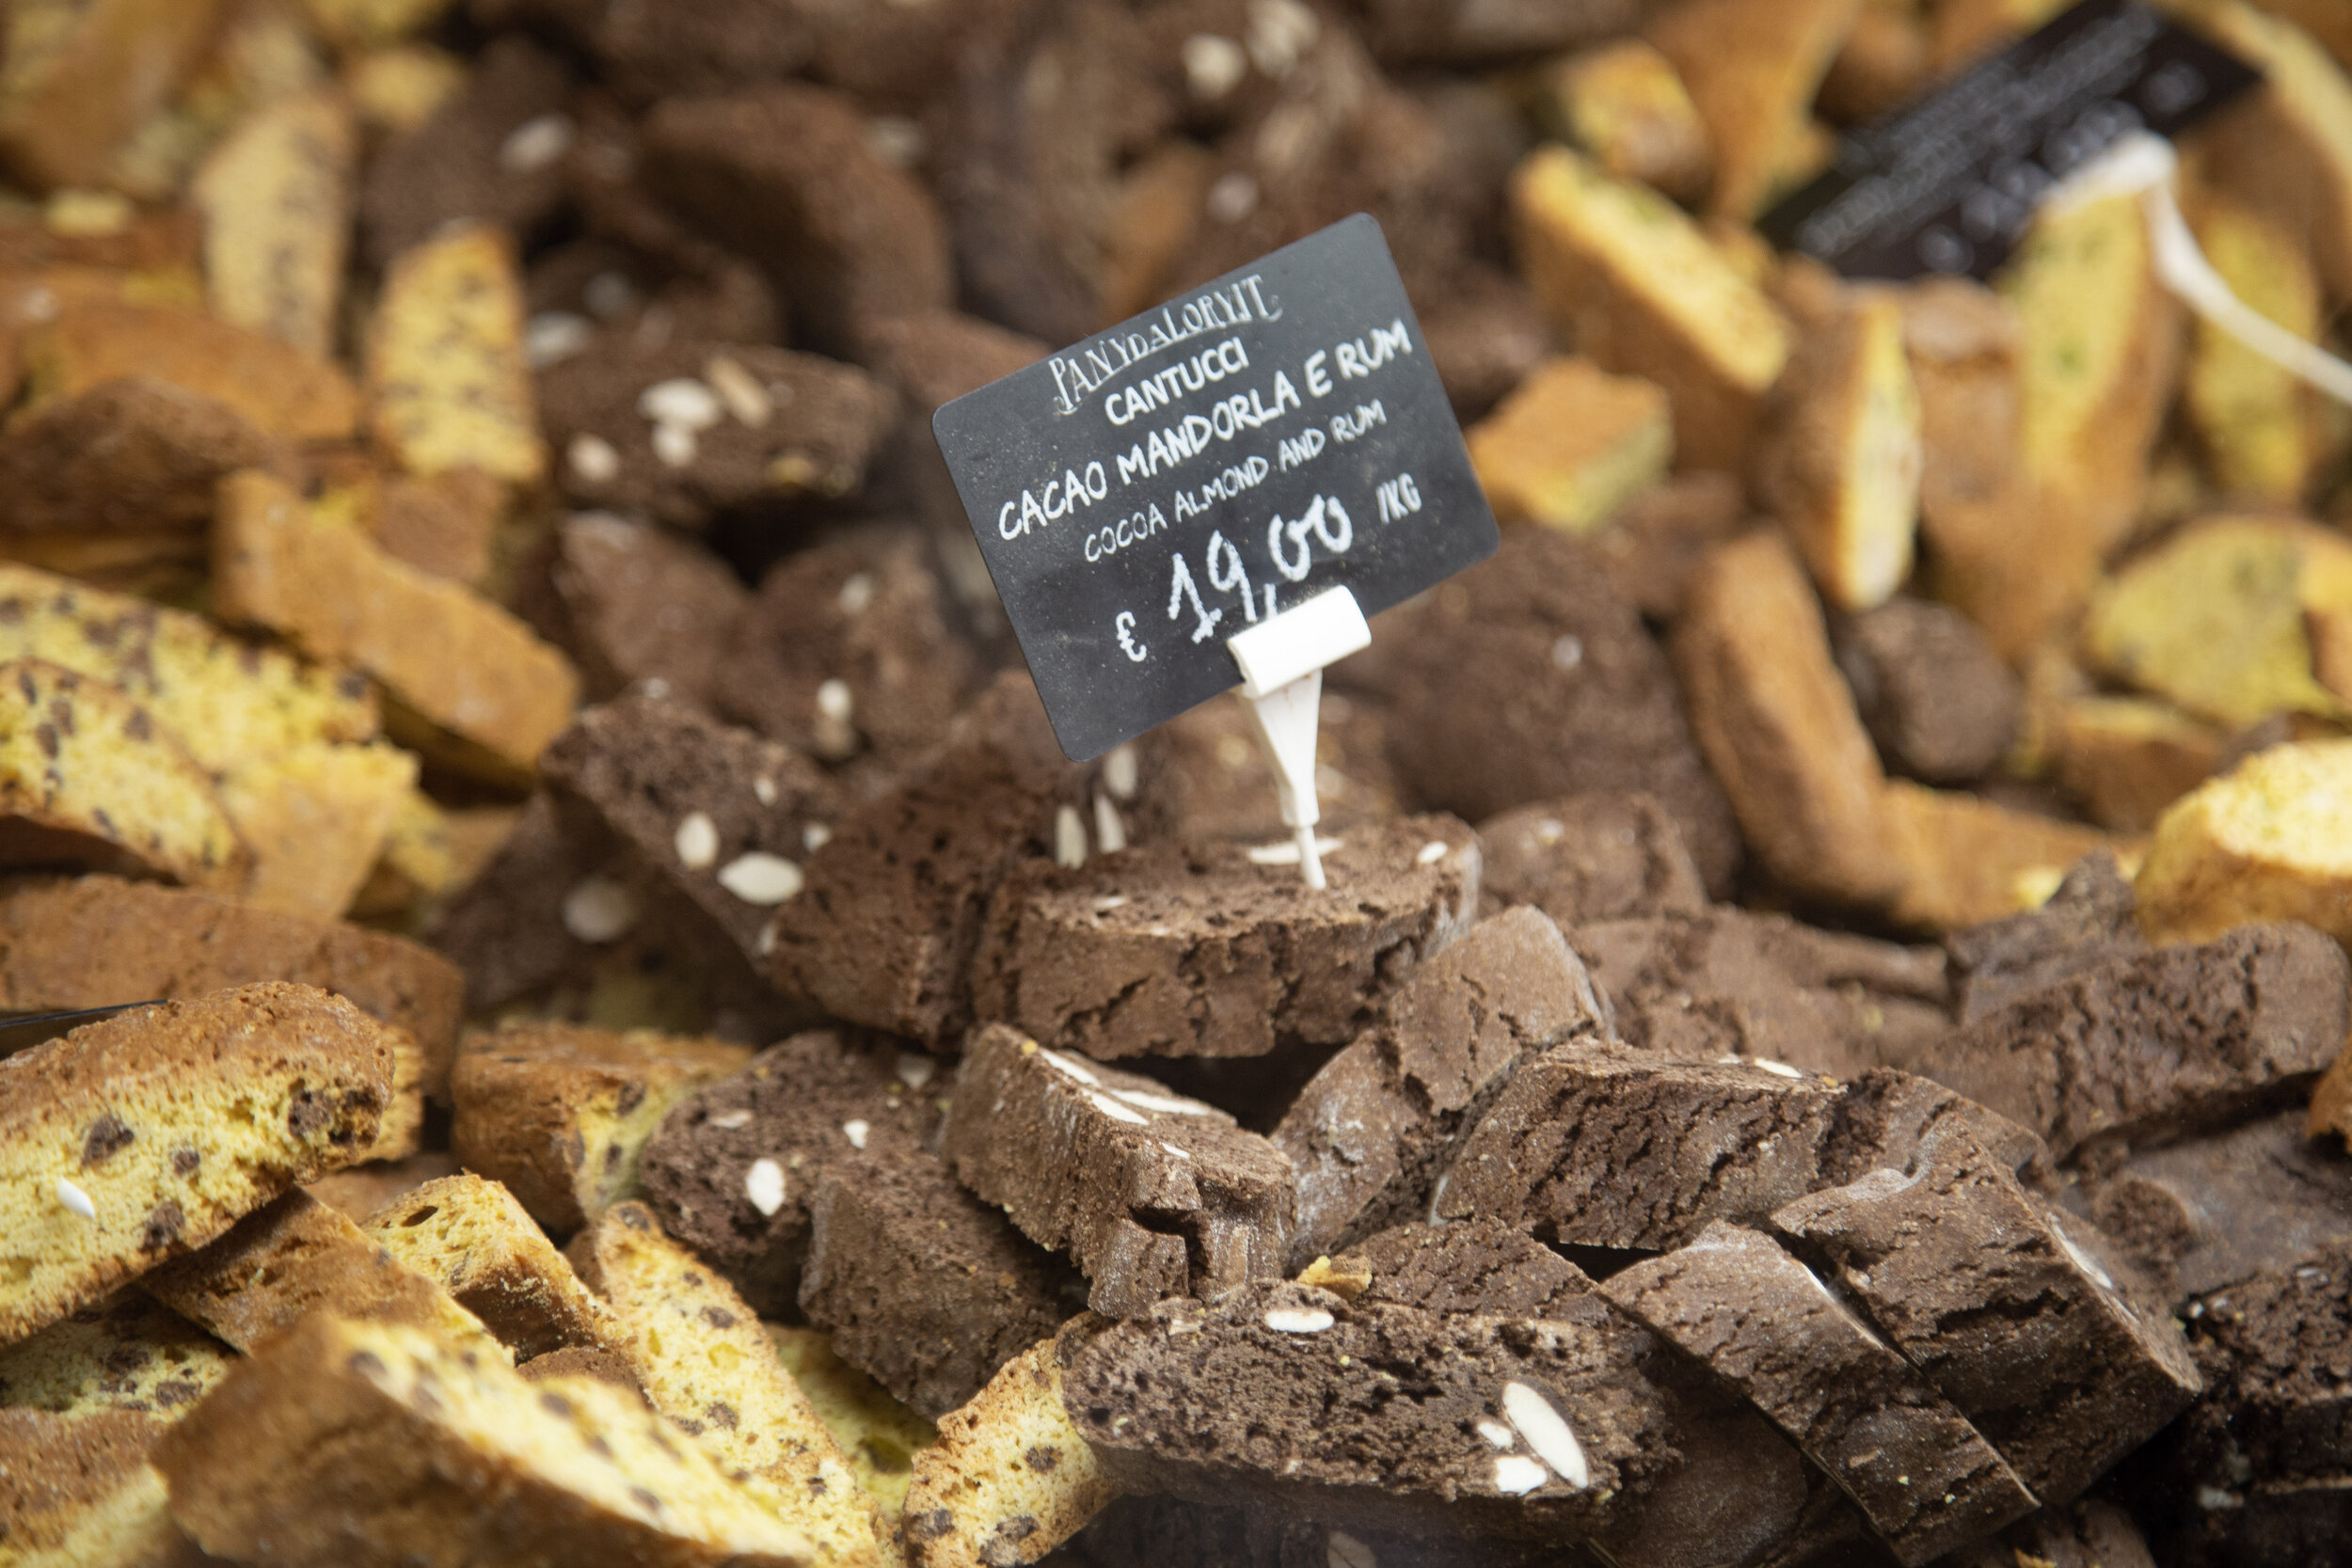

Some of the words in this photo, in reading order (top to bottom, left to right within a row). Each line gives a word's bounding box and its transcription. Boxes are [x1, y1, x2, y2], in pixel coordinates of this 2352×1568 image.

[998, 461, 1107, 542] CACAO
[1118, 371, 1301, 485] MANDORLA
[1306, 350, 1333, 397] E
[1337, 319, 1412, 379] RUM
[1104, 338, 1249, 426] CANTUCCI
[1085, 503, 1167, 562] COCOA
[1174, 455, 1268, 523] ALMOND
[1279, 428, 1326, 471] AND
[1332, 400, 1386, 443] RUM
[1116, 611, 1148, 662] €
[1376, 473, 1422, 524] /KG
